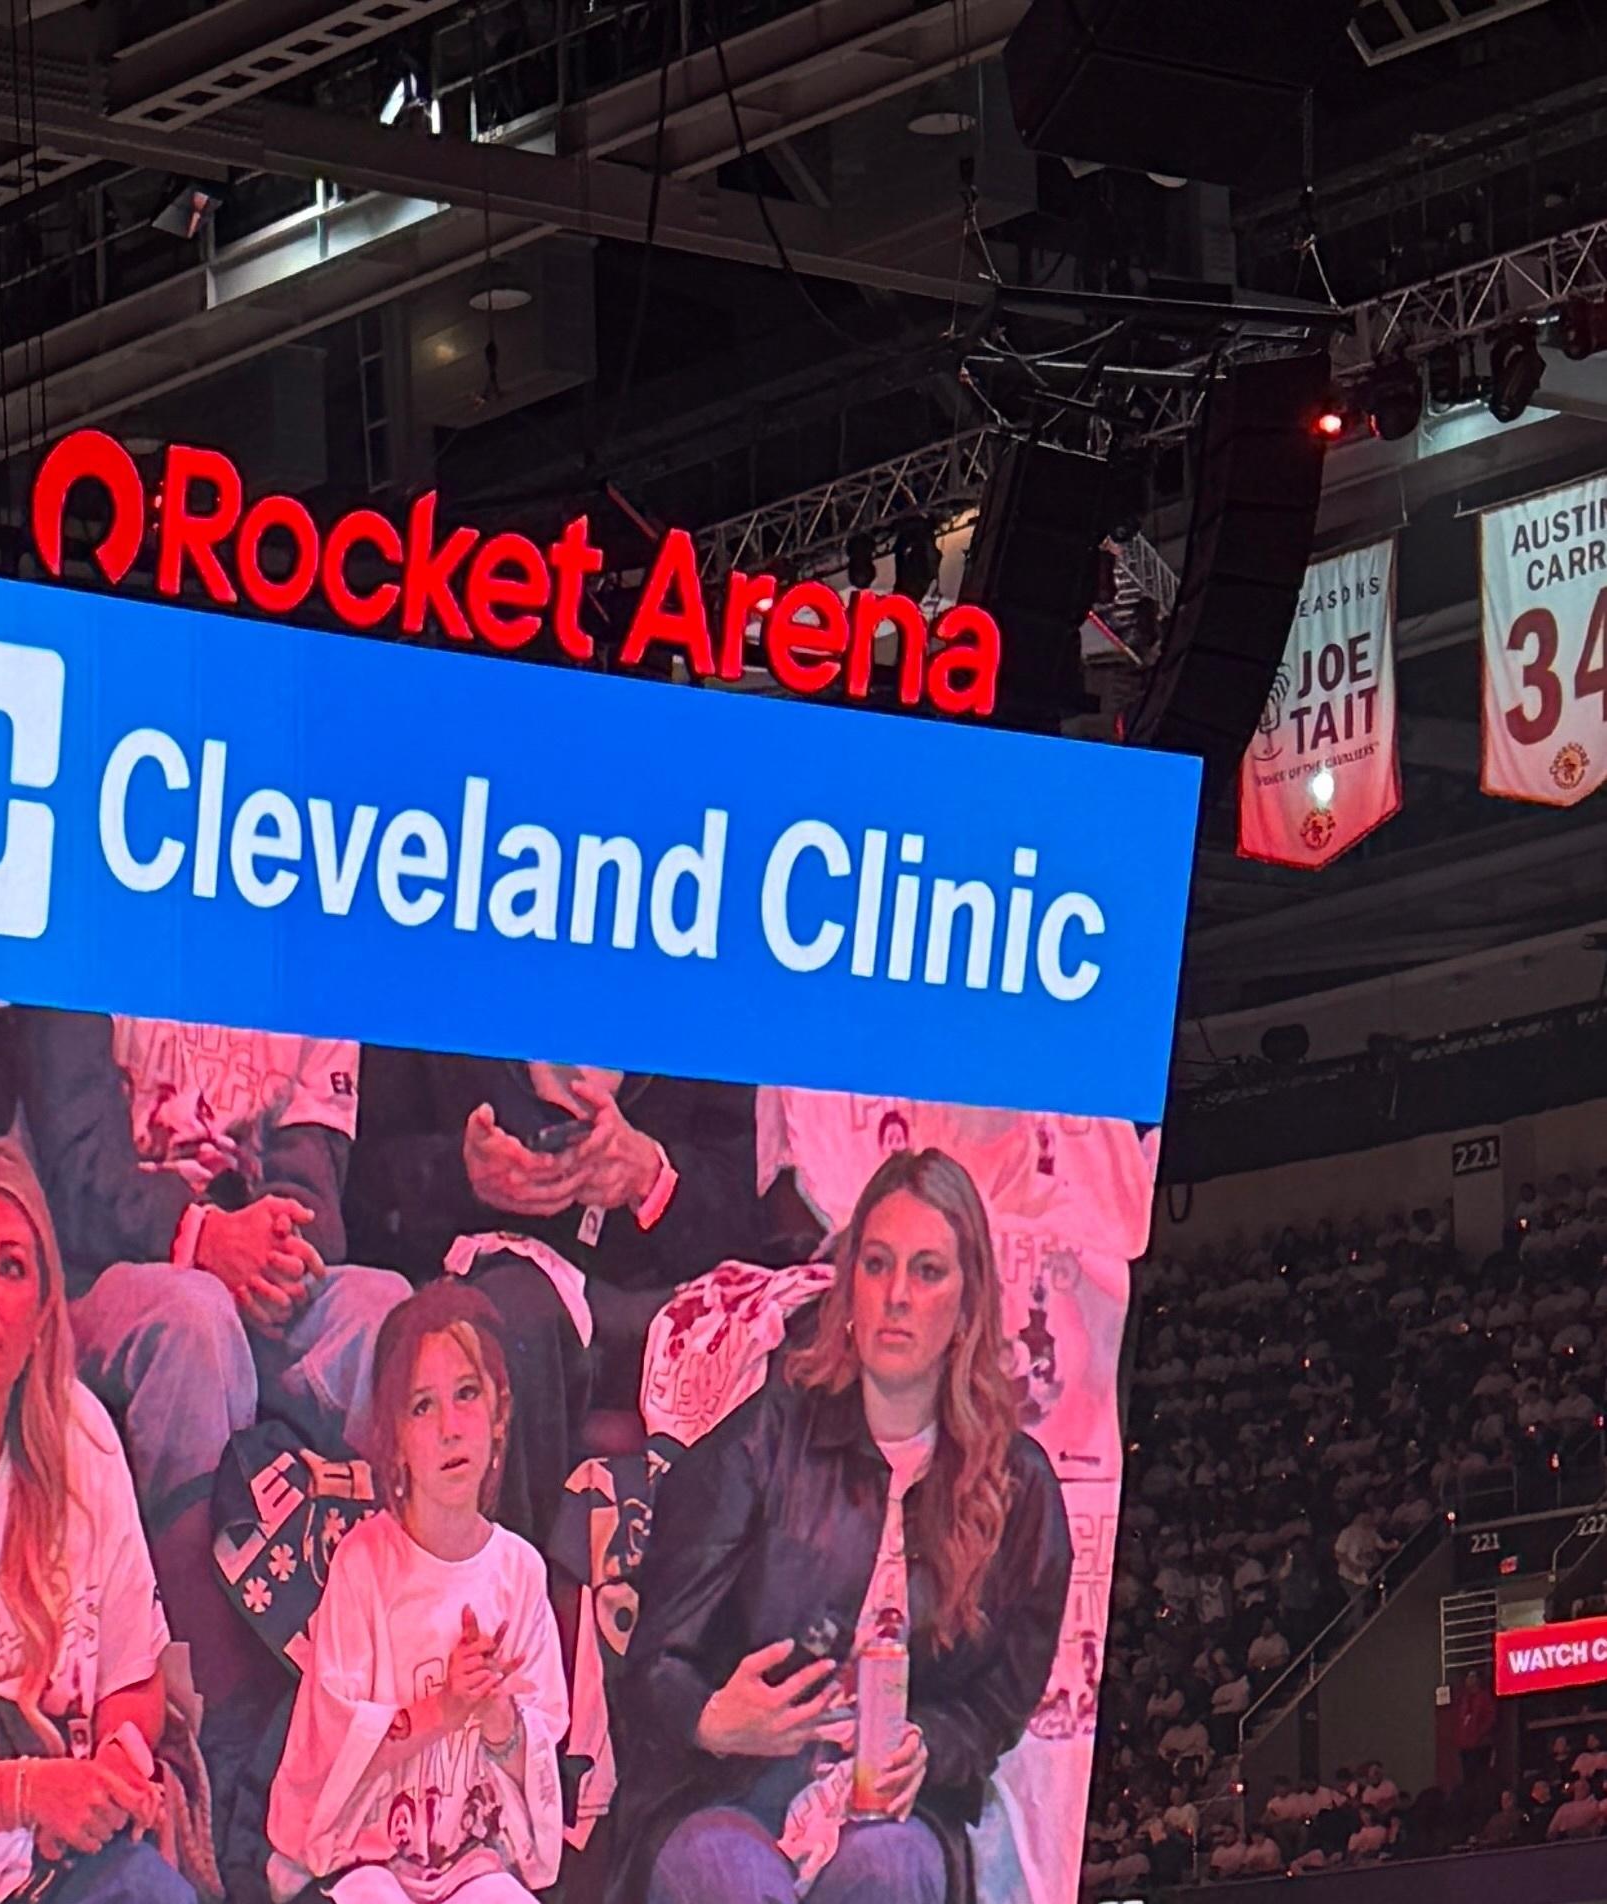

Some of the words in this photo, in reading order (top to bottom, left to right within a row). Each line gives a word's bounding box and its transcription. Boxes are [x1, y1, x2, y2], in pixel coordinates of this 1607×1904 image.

[156, 444, 601, 662] Rocket
[621, 529, 1000, 716] Arena
[1298, 632, 1372, 699] JOE
[1290, 686, 1378, 755] TAIT
[99, 727, 726, 960] Cleveland
[760, 819, 1105, 1002] Clinic
[1455, 1141, 1498, 1173] 221
[1509, 1640, 1587, 1674] WATCH
